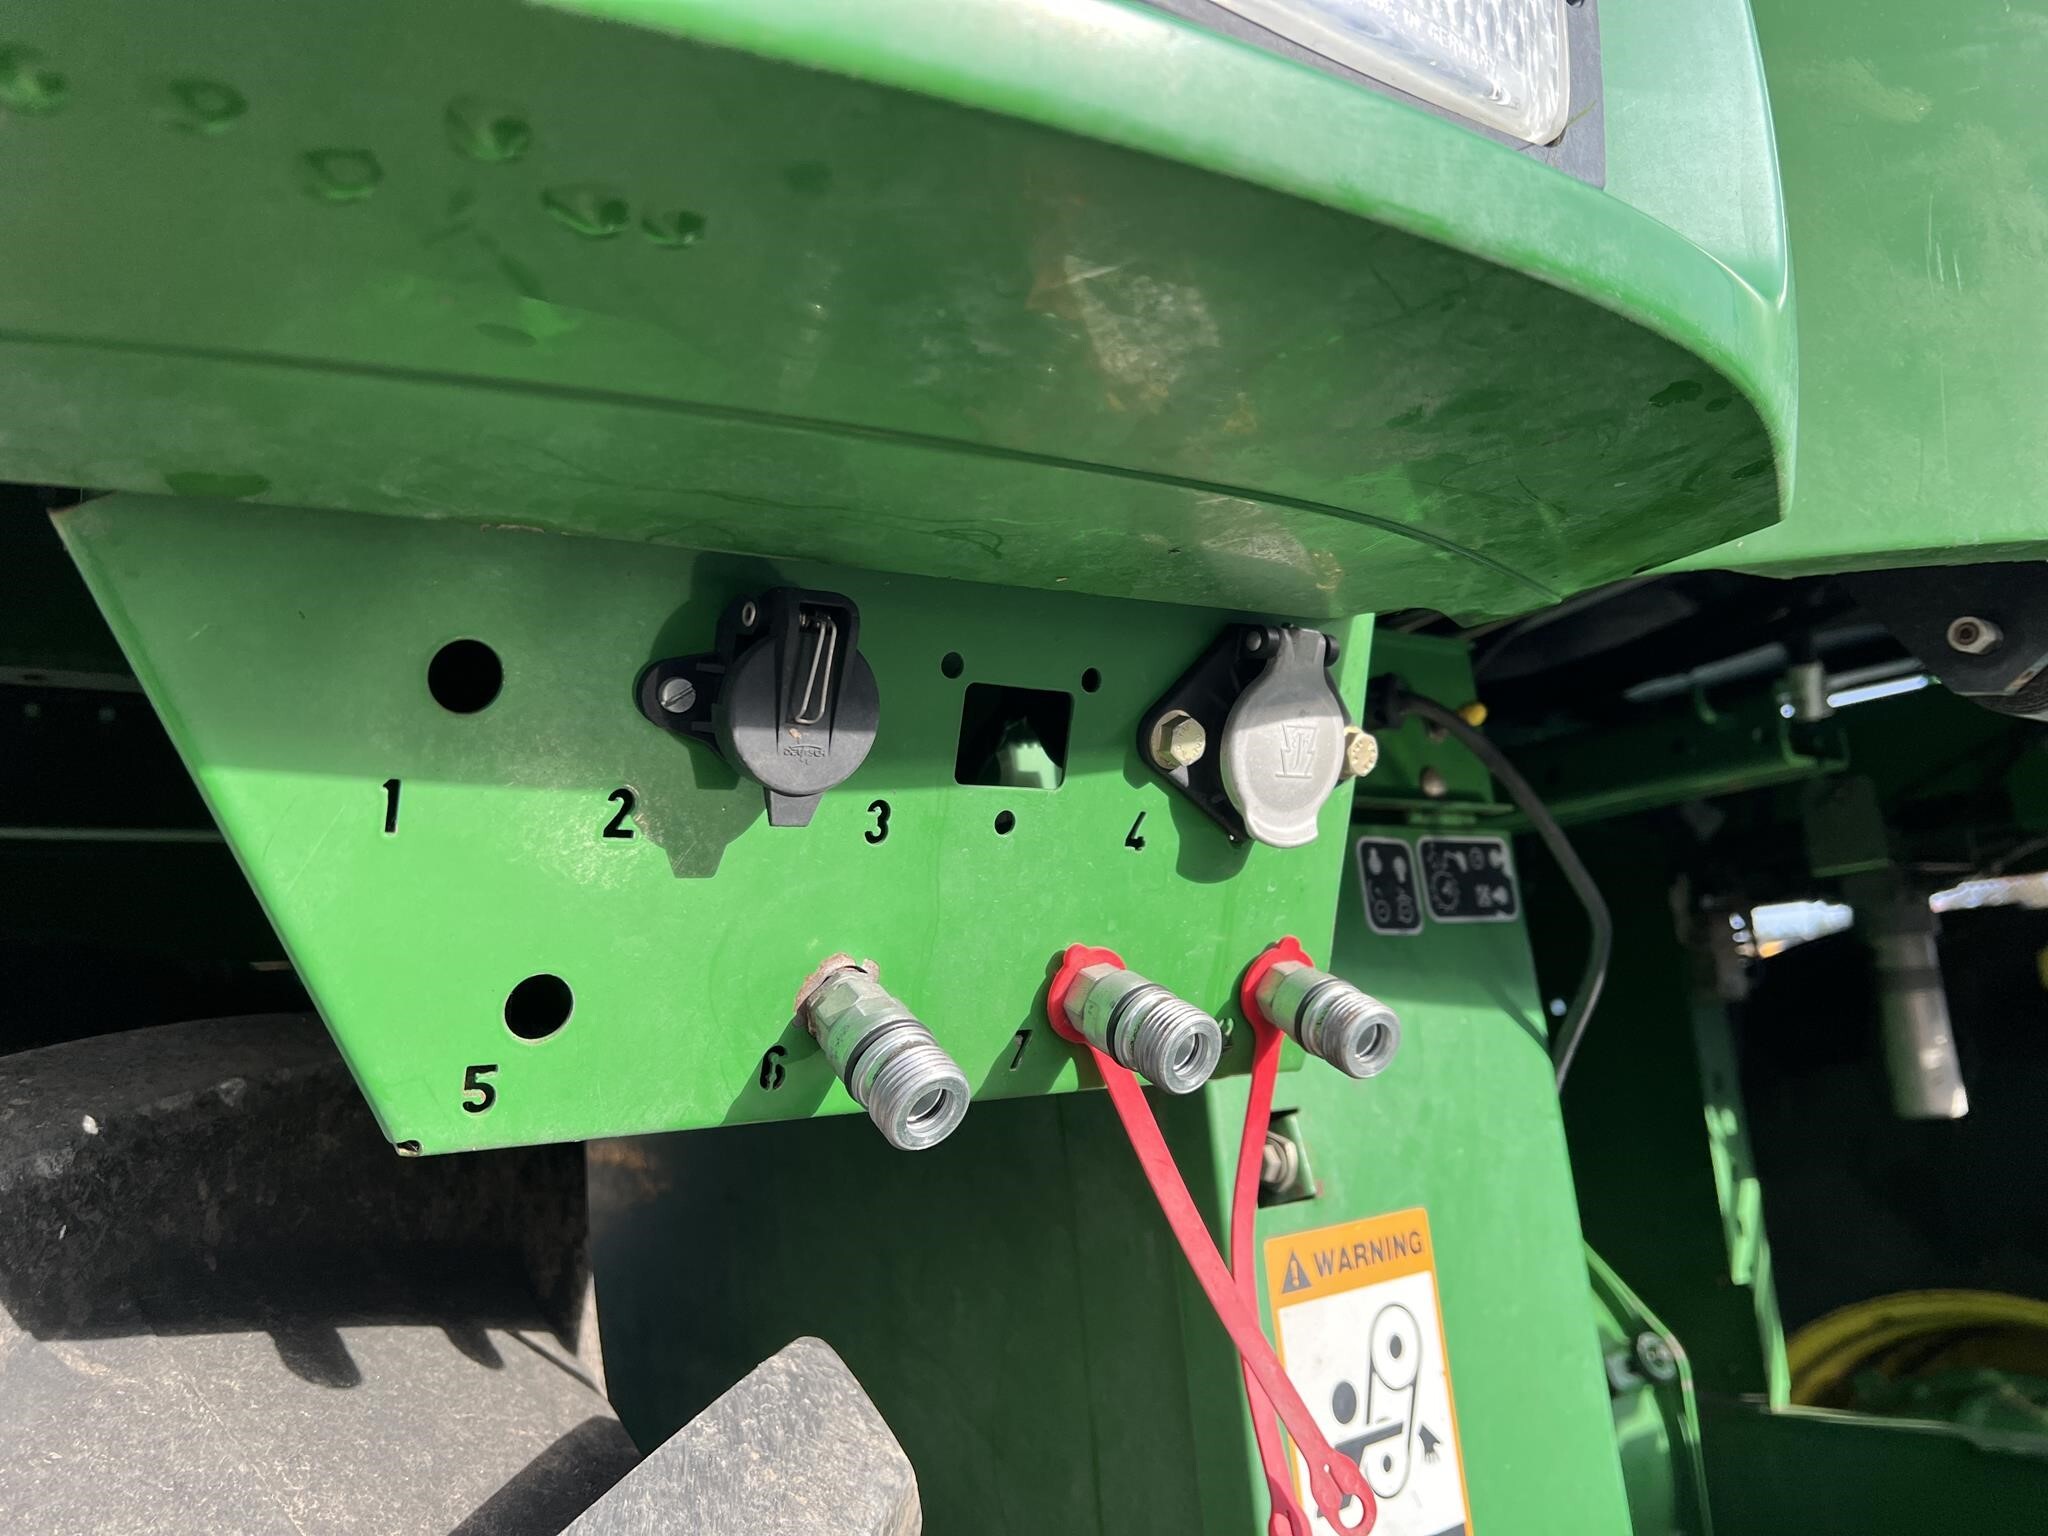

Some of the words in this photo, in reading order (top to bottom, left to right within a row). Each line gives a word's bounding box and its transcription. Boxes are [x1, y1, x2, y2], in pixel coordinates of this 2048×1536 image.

[384, 779, 401, 833] 1
[602, 788, 636, 839] 2
[865, 799, 891, 844] 3
[1124, 811, 1147, 852] 4
[760, 1045, 787, 1091] 6
[1010, 1029, 1033, 1070] 7
[462, 1064, 499, 1114] 5
[1312, 1231, 1424, 1278] WARNING
